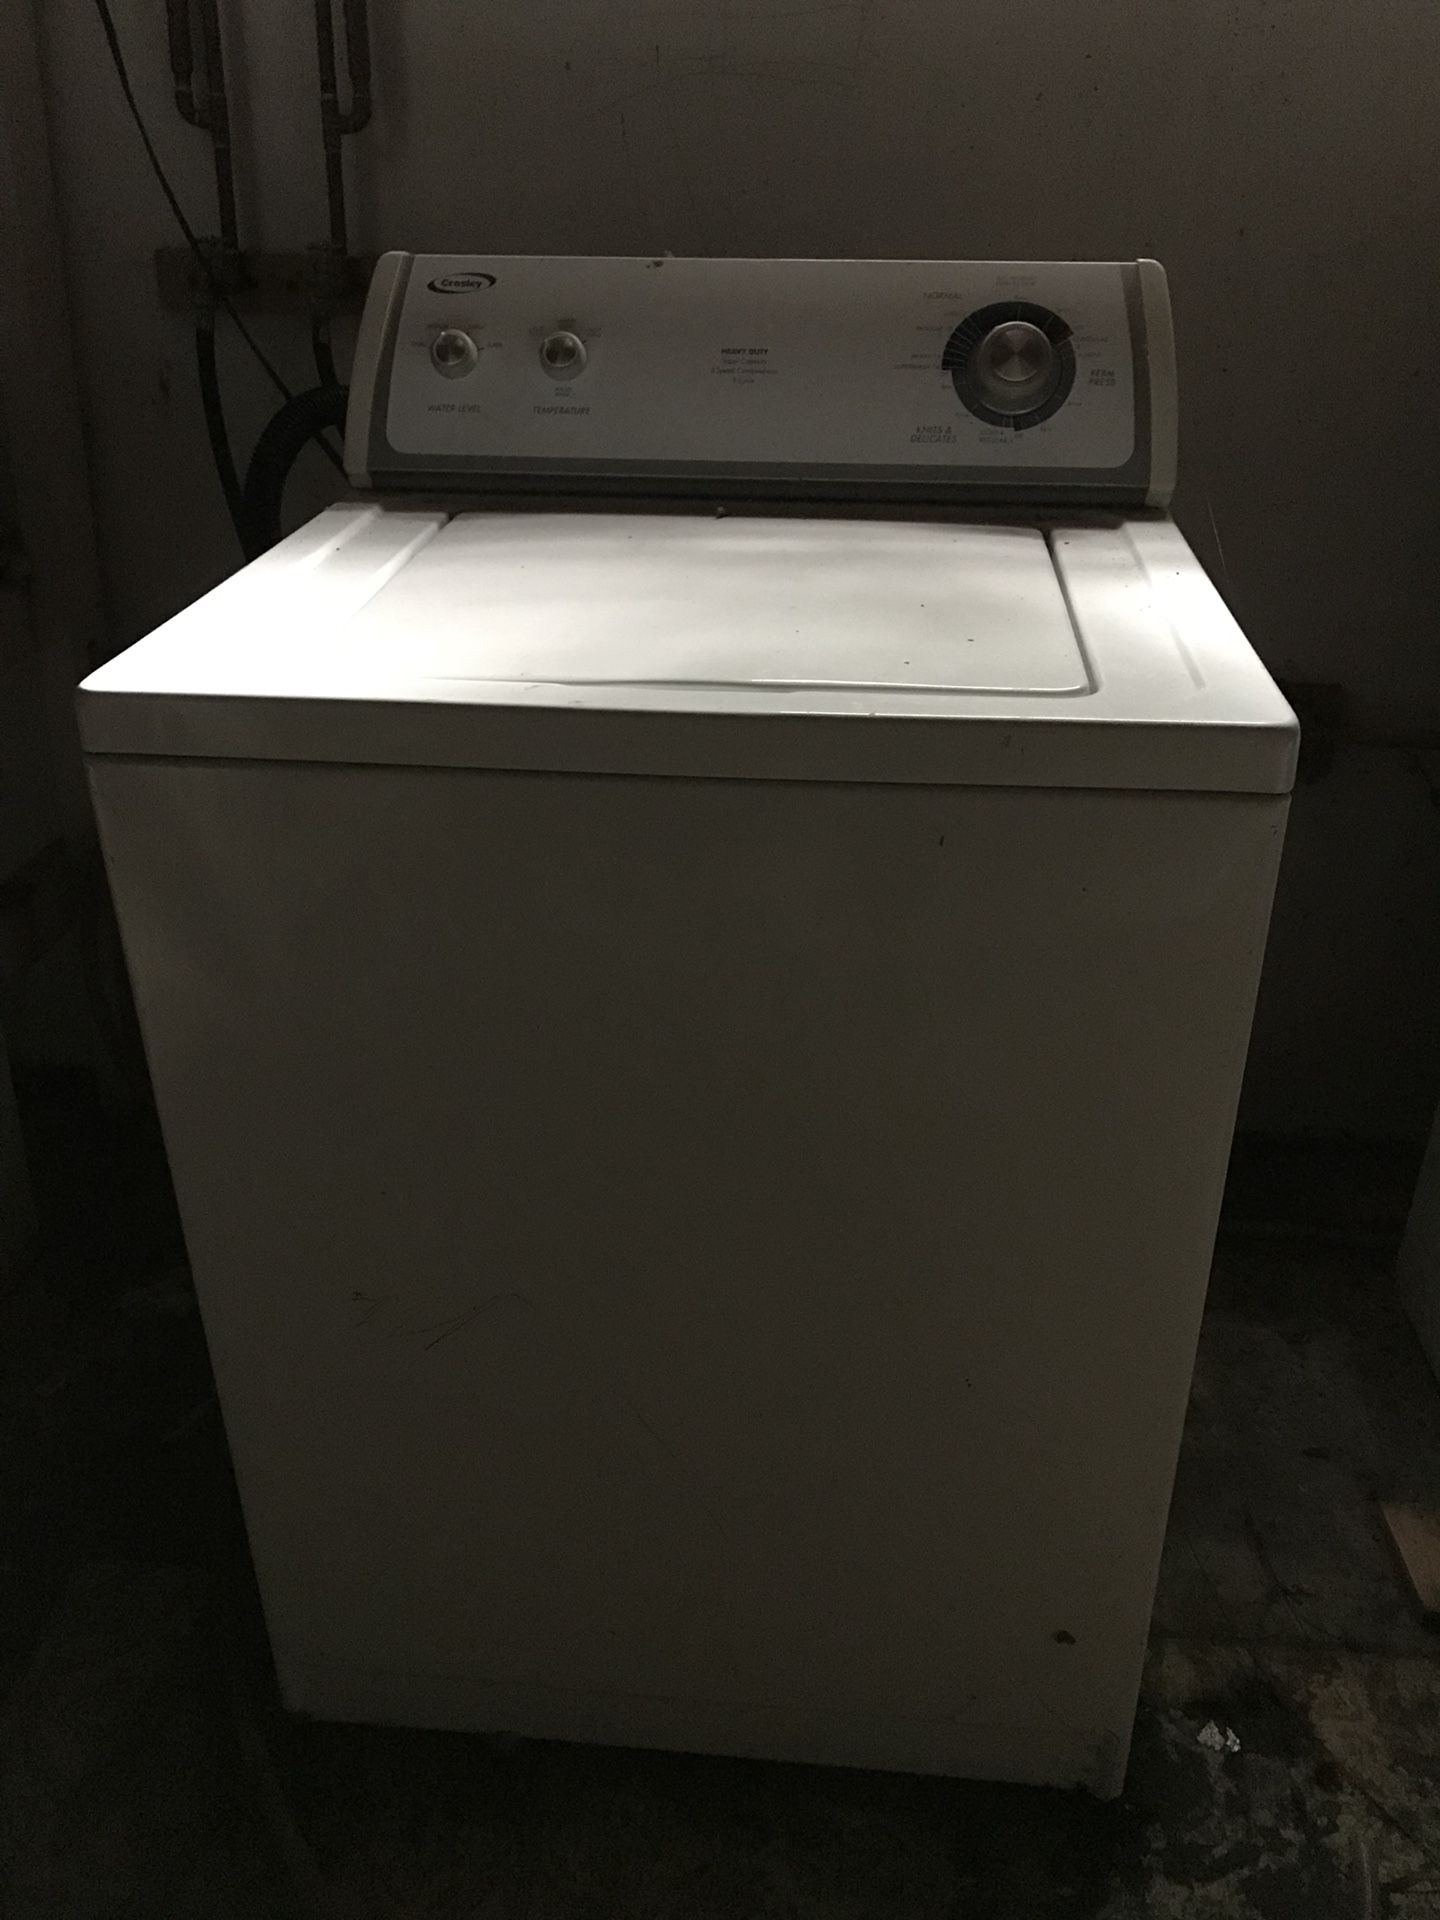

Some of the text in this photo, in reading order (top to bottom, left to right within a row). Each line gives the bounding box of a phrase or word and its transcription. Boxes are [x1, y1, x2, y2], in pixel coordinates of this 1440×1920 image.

[441, 278, 483, 289] Crosley
[427, 404, 481, 413] WATER LEVEL
[533, 405, 592, 416] TEMPERATURE
[910, 433, 958, 443] DELICATES
